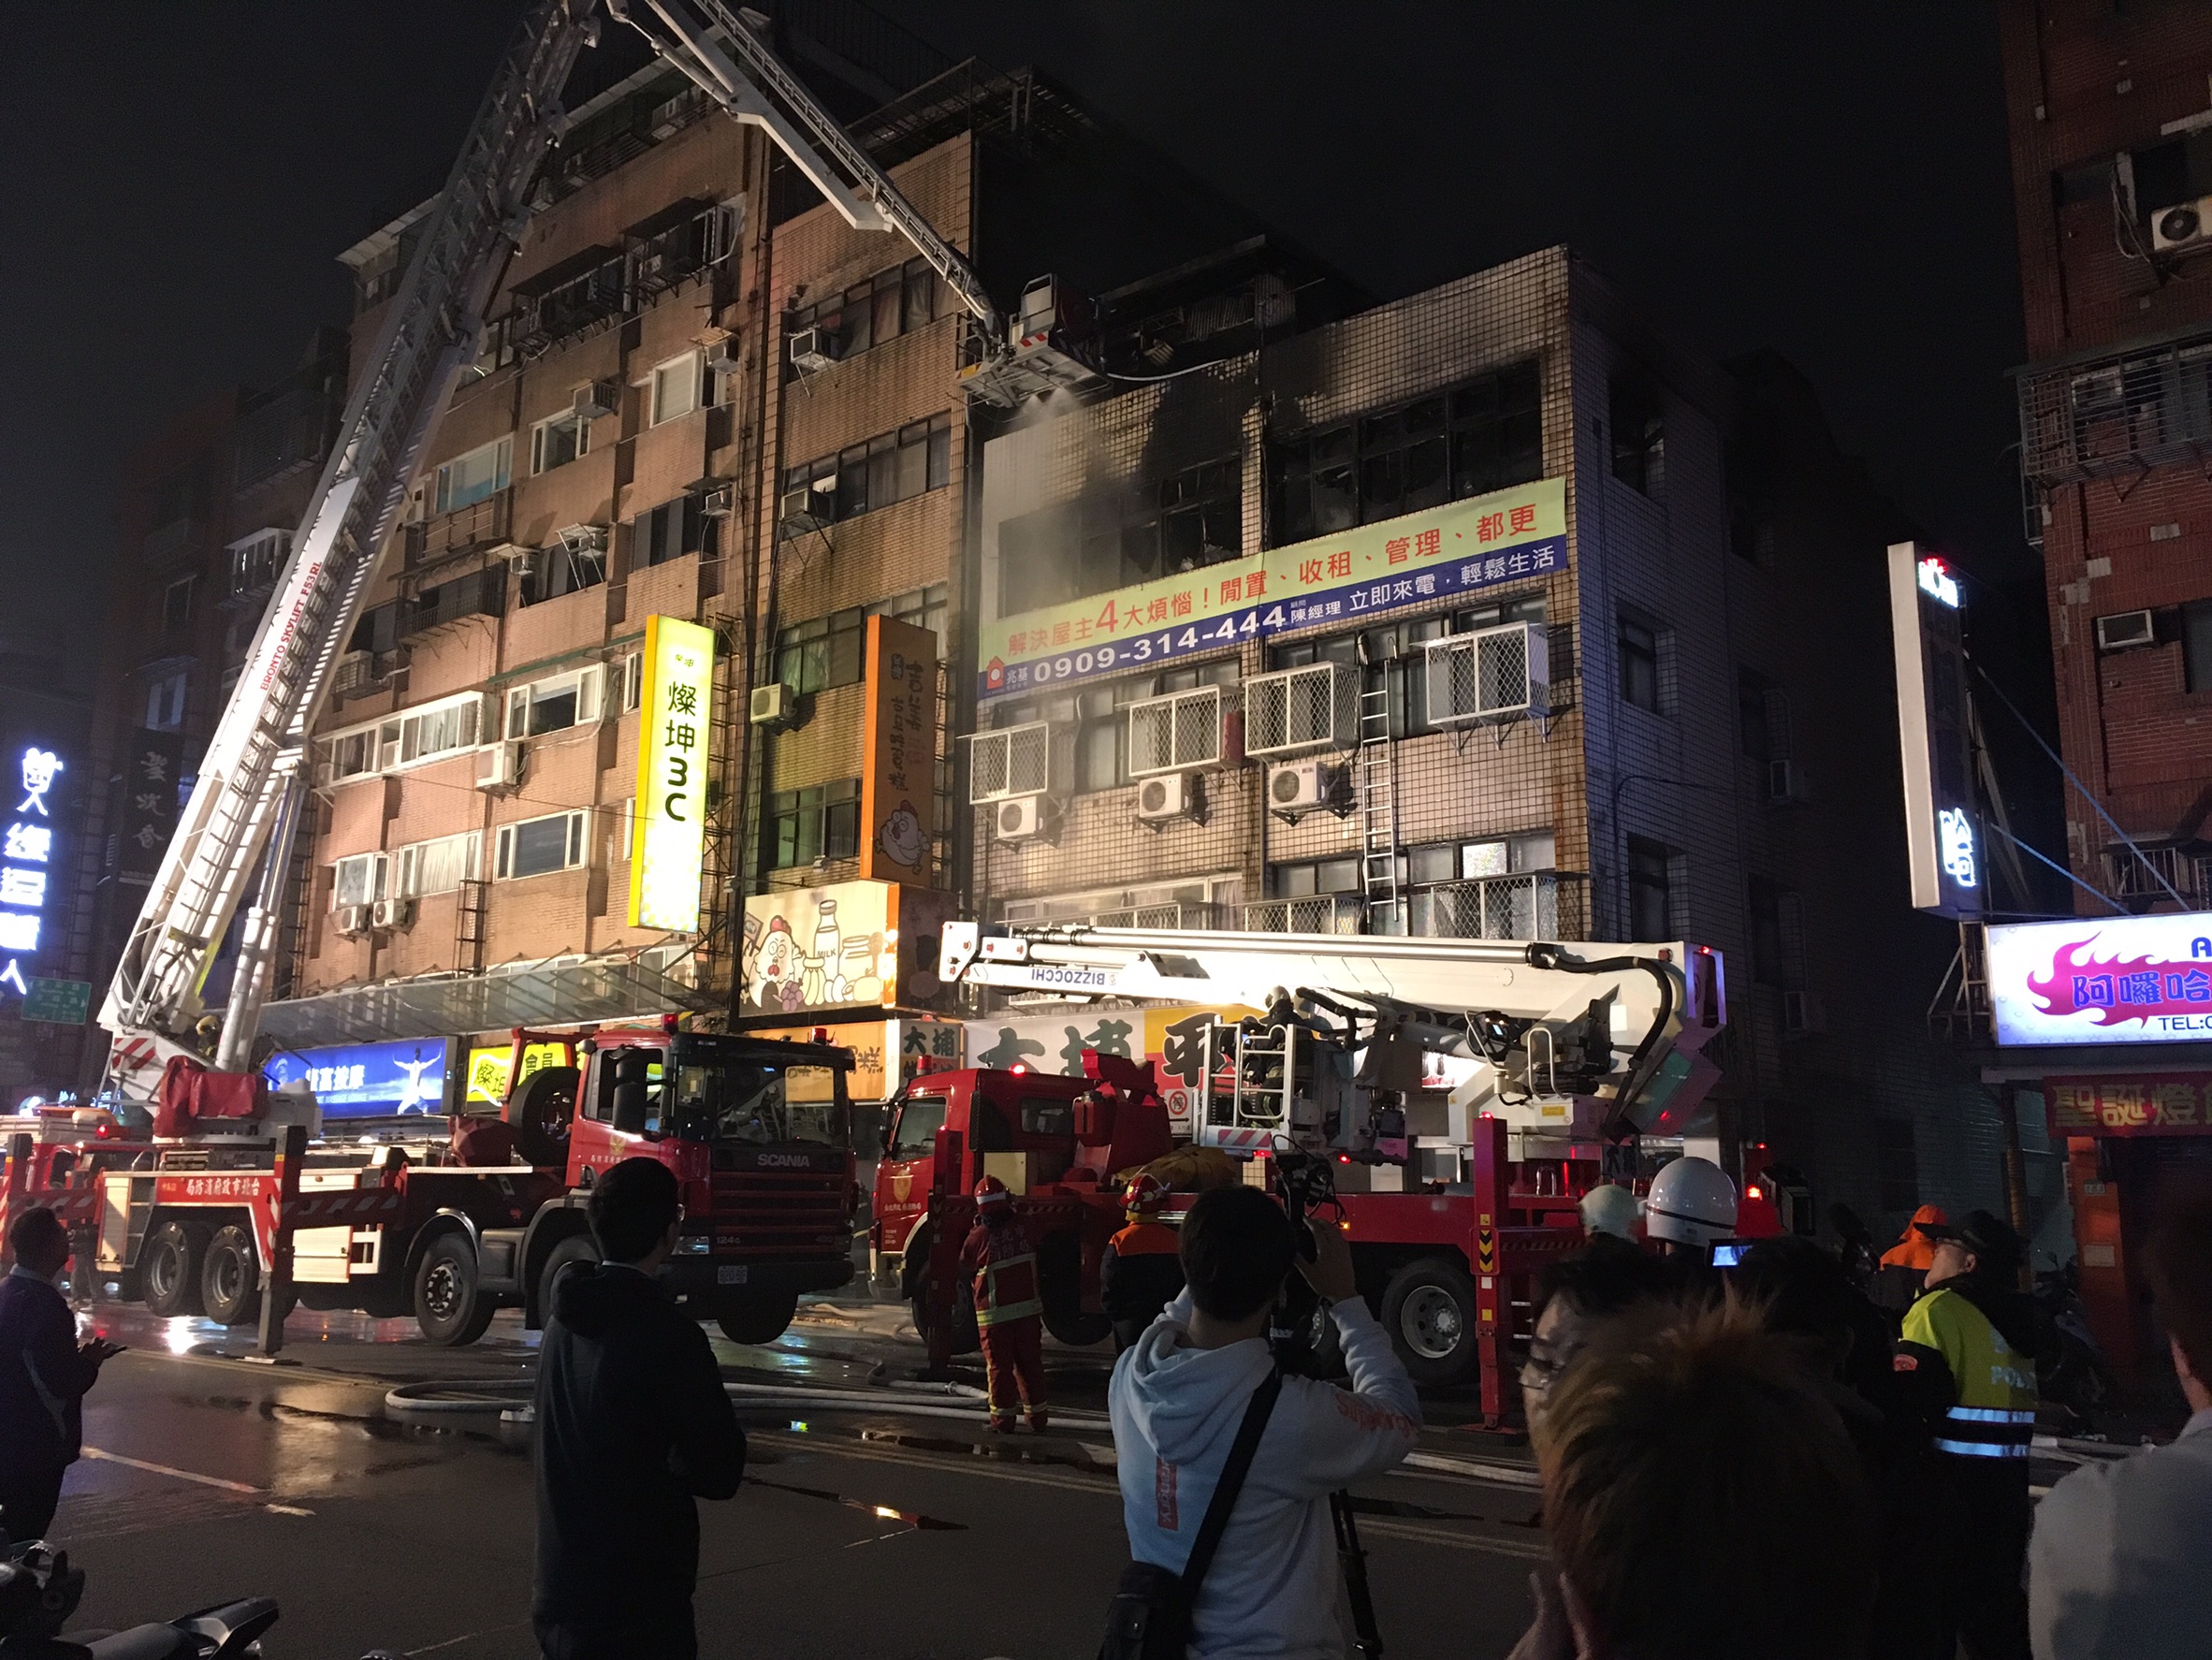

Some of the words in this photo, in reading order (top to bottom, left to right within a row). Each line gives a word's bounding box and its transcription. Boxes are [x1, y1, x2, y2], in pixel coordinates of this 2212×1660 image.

[260, 645, 285, 692] BRONTO
[281, 599, 306, 644] SKYLIFT
[300, 561, 323, 597] F53RL
[1006, 666, 1028, 685] 兆基
[1034, 604, 1287, 682] 0909-314-444
[1290, 601, 1342, 624] 陳經理
[817, 948, 837, 959] MILK
[1031, 968, 1105, 985] BIZZOCCHI
[2072, 968, 2211, 1009] 阿囉哈
[757, 1153, 810, 1168] SCANIA
